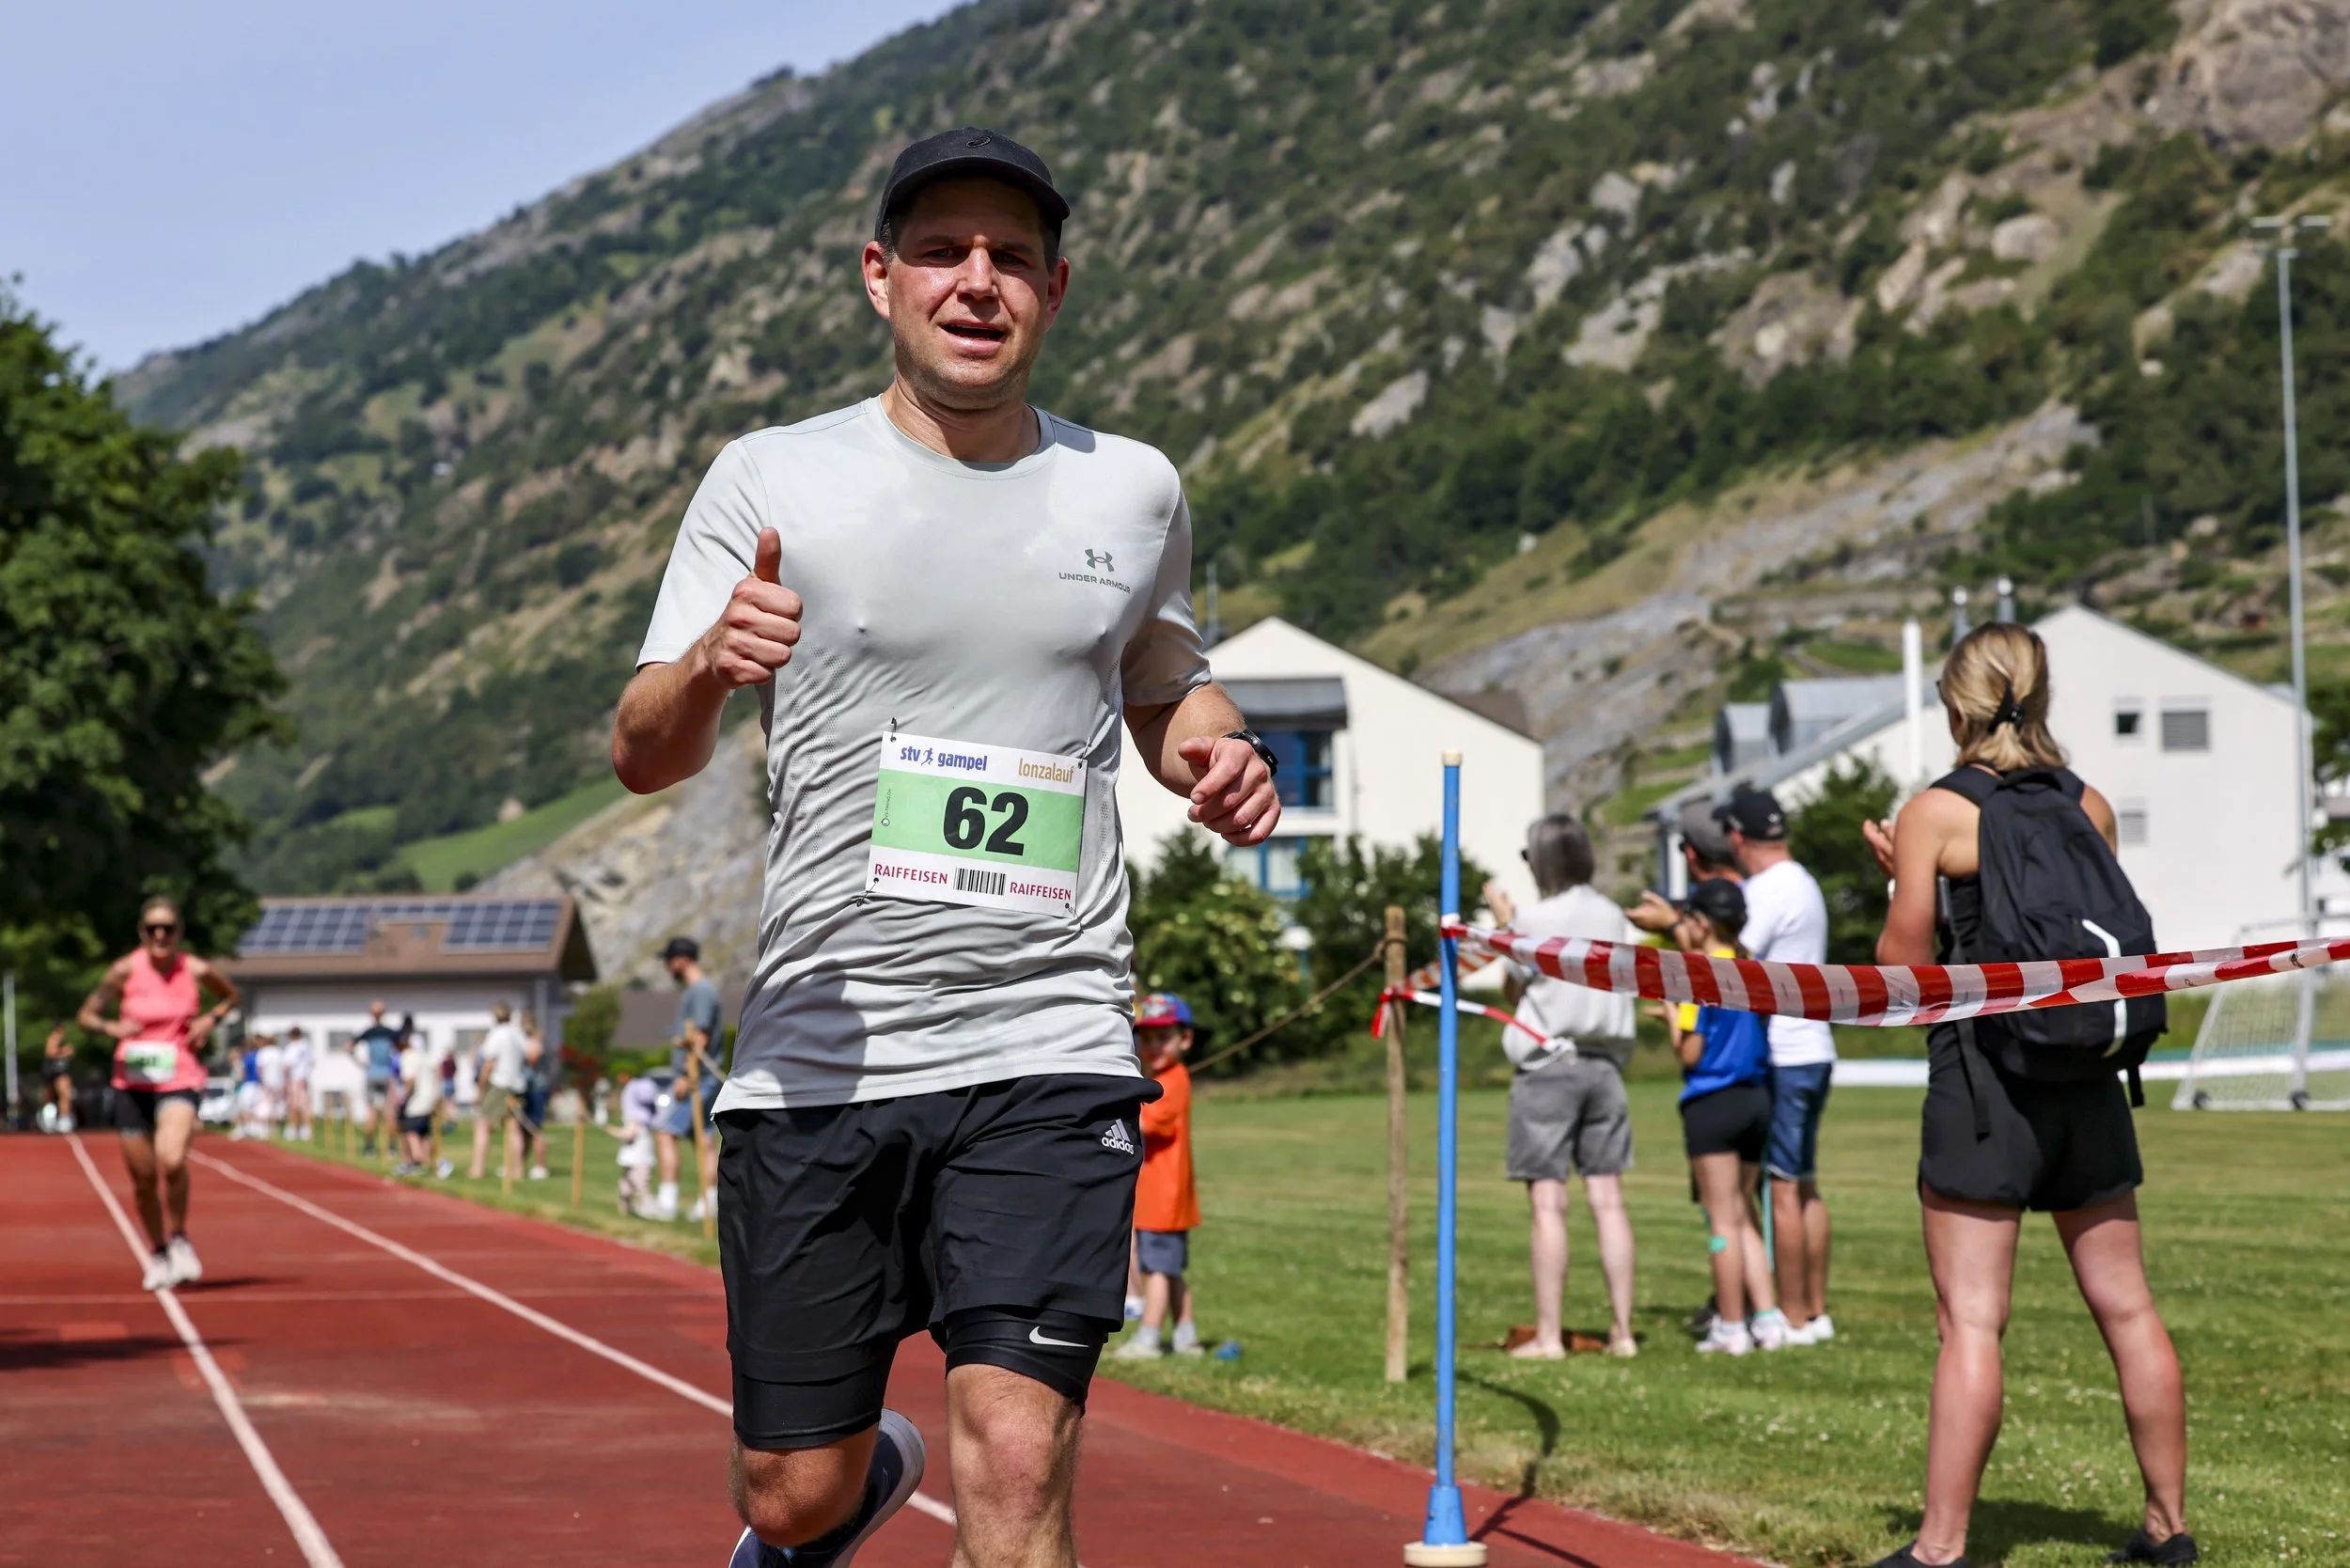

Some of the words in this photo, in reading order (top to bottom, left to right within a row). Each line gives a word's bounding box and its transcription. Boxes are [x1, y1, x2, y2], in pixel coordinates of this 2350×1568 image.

[1058, 572, 1098, 584] UNDER
[1099, 578, 1131, 594] ARMOUR
[900, 745, 921, 762] stv
[937, 752, 988, 771] gampel
[1018, 758, 1074, 784] lonzalauf
[943, 786, 1029, 856] 62
[874, 863, 948, 885] RAIFFEISEN
[1010, 882, 1072, 901] RAIFFEISEN
[1101, 1137, 1135, 1155] adidas
